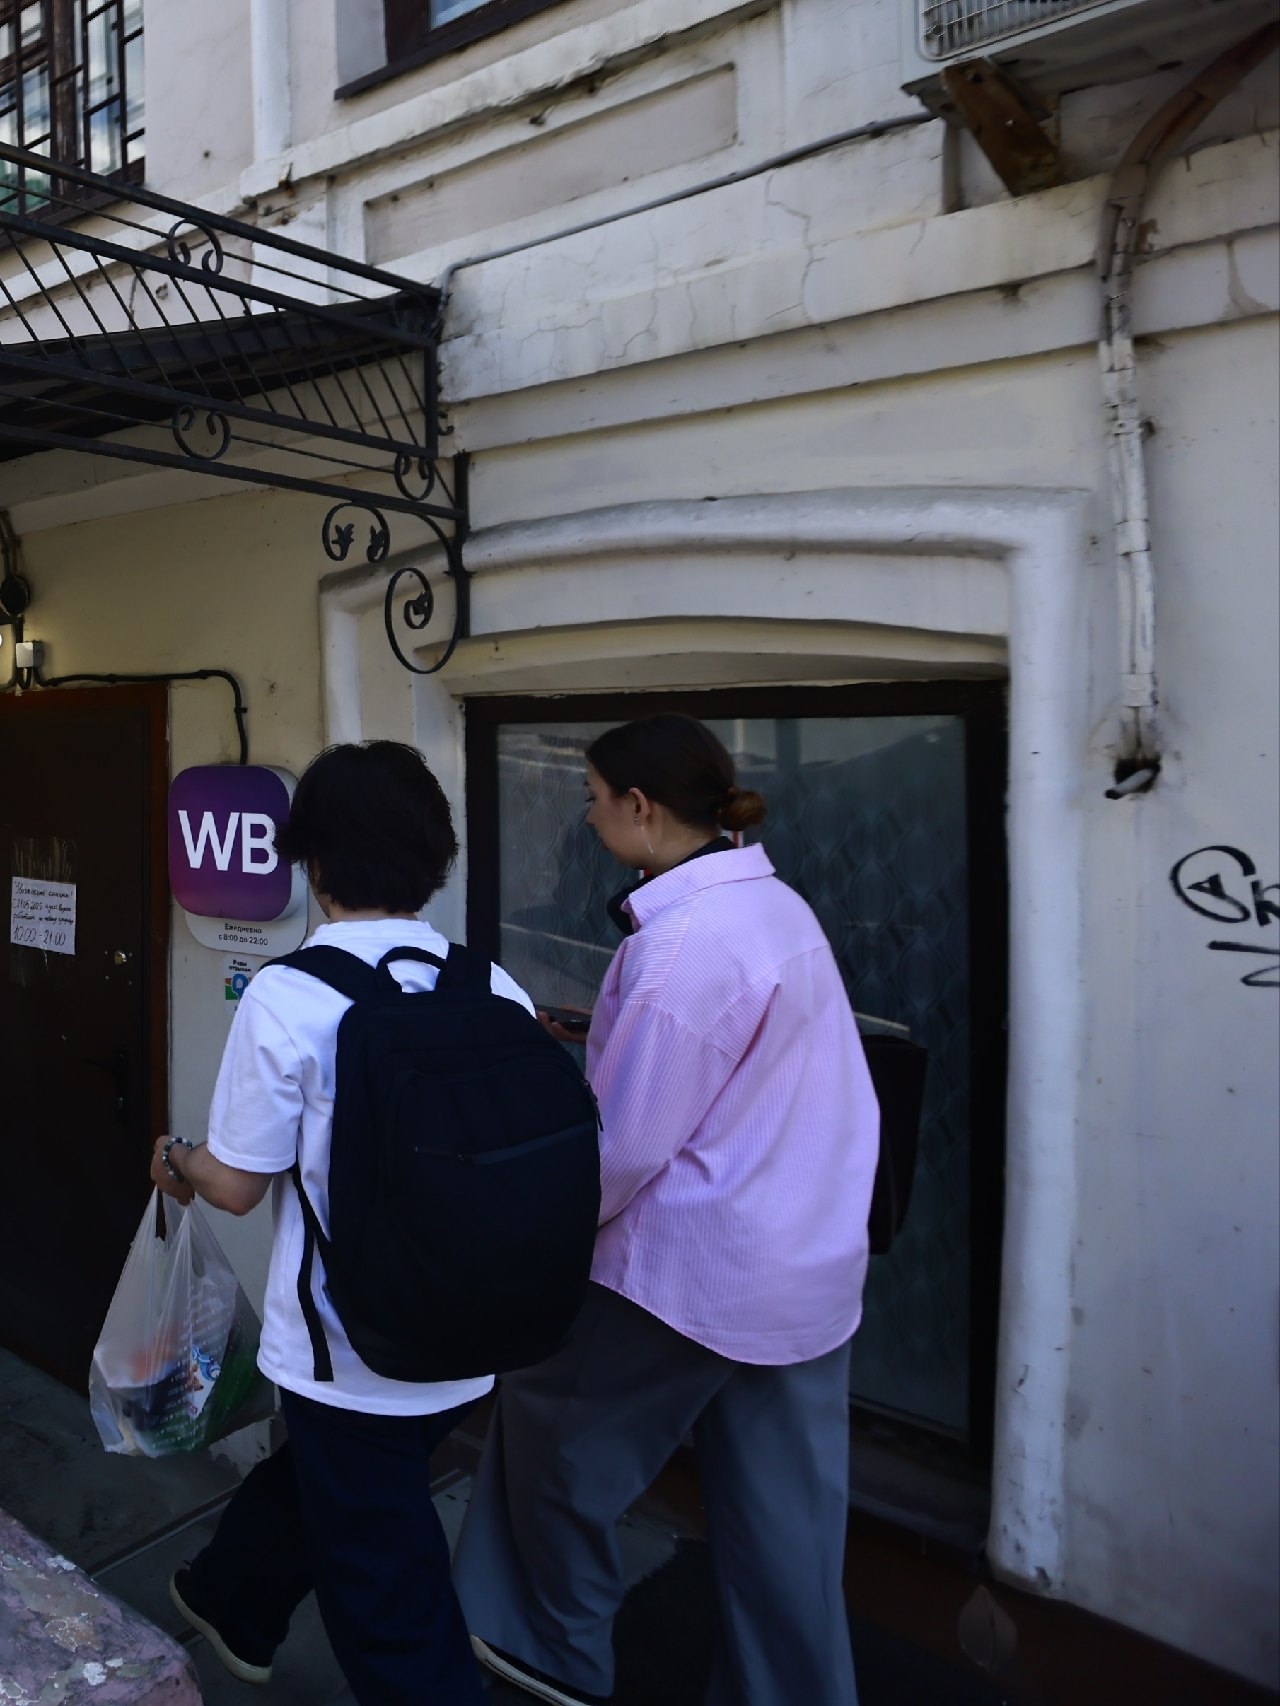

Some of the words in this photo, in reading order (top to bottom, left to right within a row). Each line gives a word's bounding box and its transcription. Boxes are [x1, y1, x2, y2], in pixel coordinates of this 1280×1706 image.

[178, 810, 279, 875] WB
[225, 923, 262, 934] Ежедневно
[223, 934, 238, 942] 8:00
[249, 937, 269, 946] 22:00
